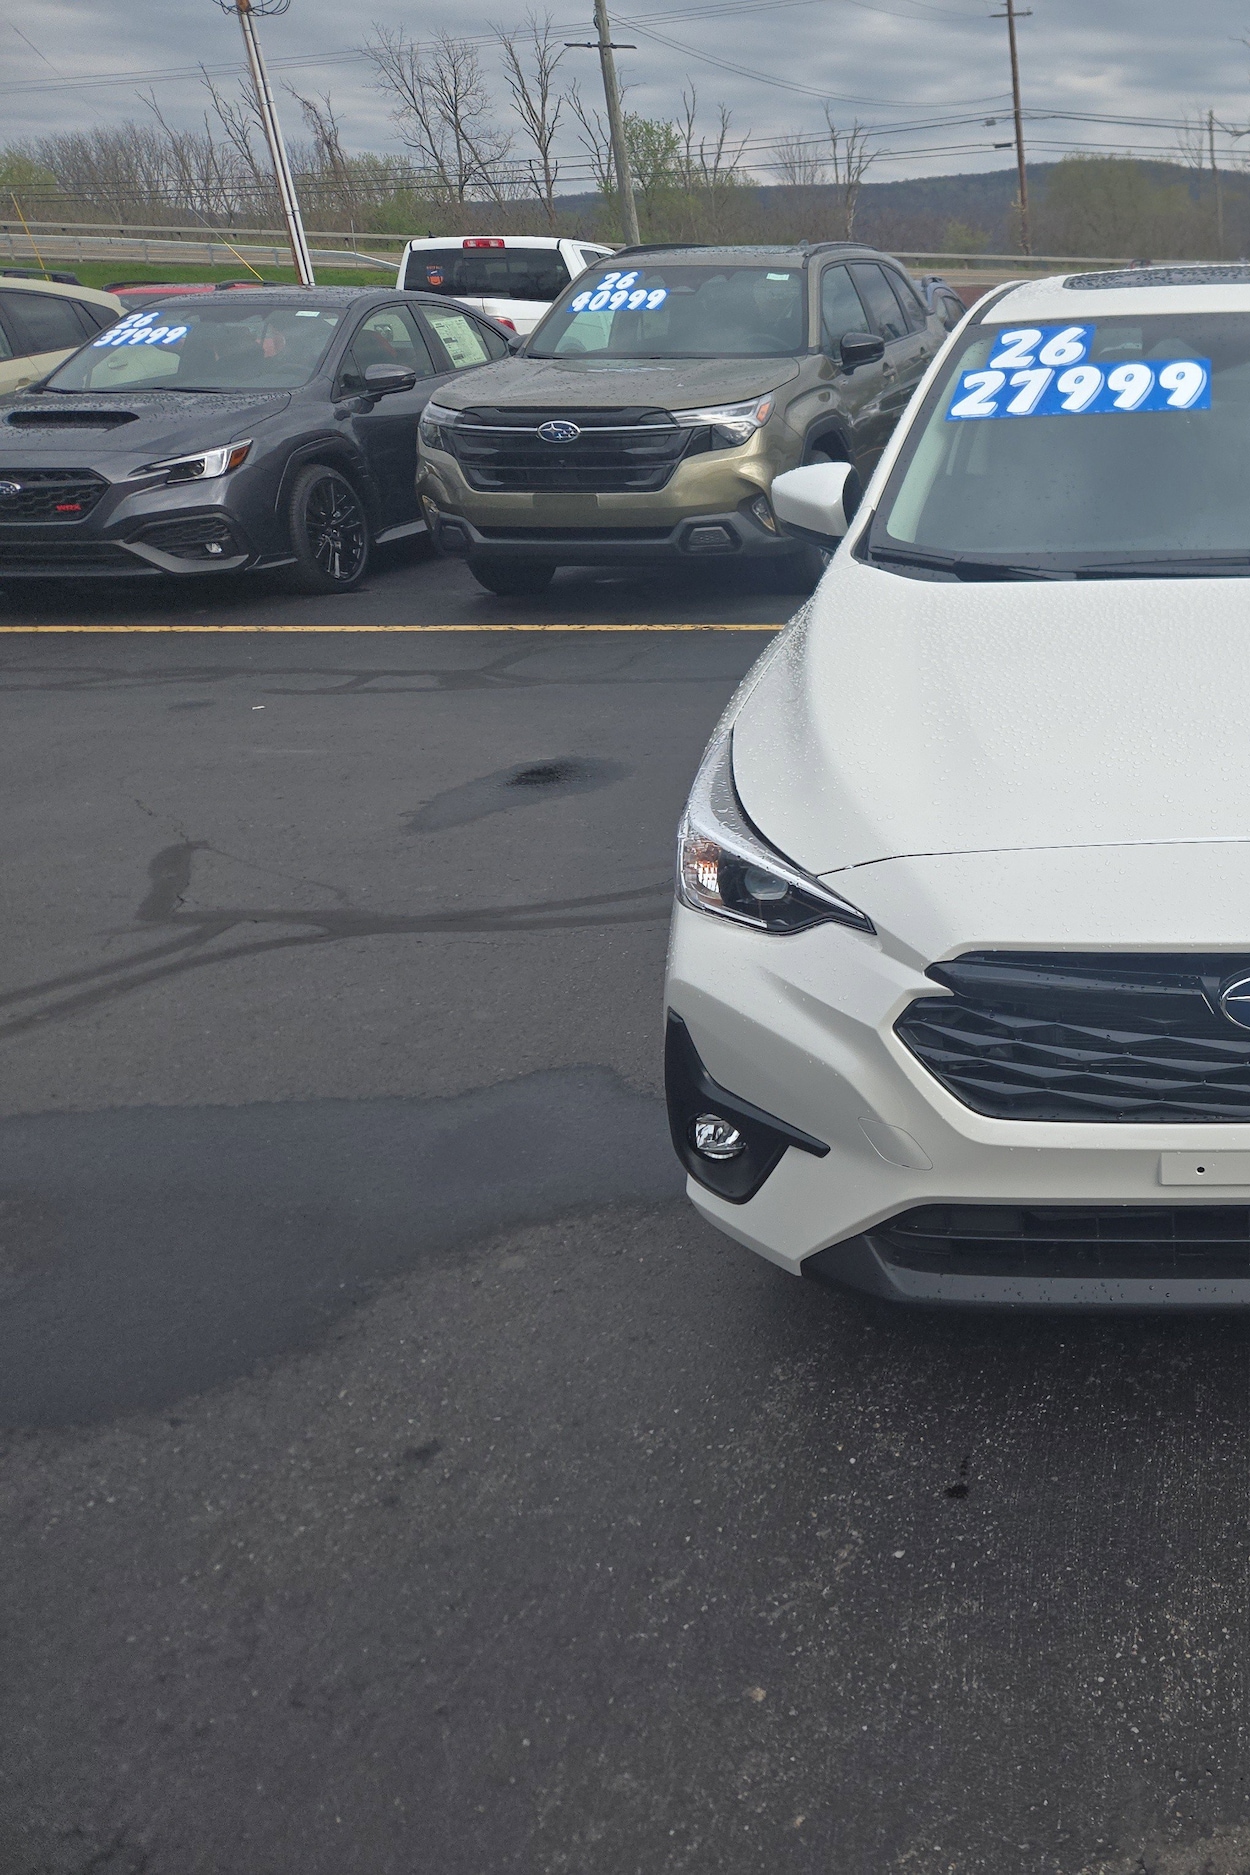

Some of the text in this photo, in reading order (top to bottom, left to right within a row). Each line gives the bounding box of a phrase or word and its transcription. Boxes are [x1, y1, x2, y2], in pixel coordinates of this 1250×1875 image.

[596, 271, 639, 291] 26
[571, 289, 667, 312] 40999
[115, 312, 160, 330] 26
[93, 326, 188, 347] 37999
[989, 326, 1087, 369] 26
[950, 361, 1208, 418] 27999
